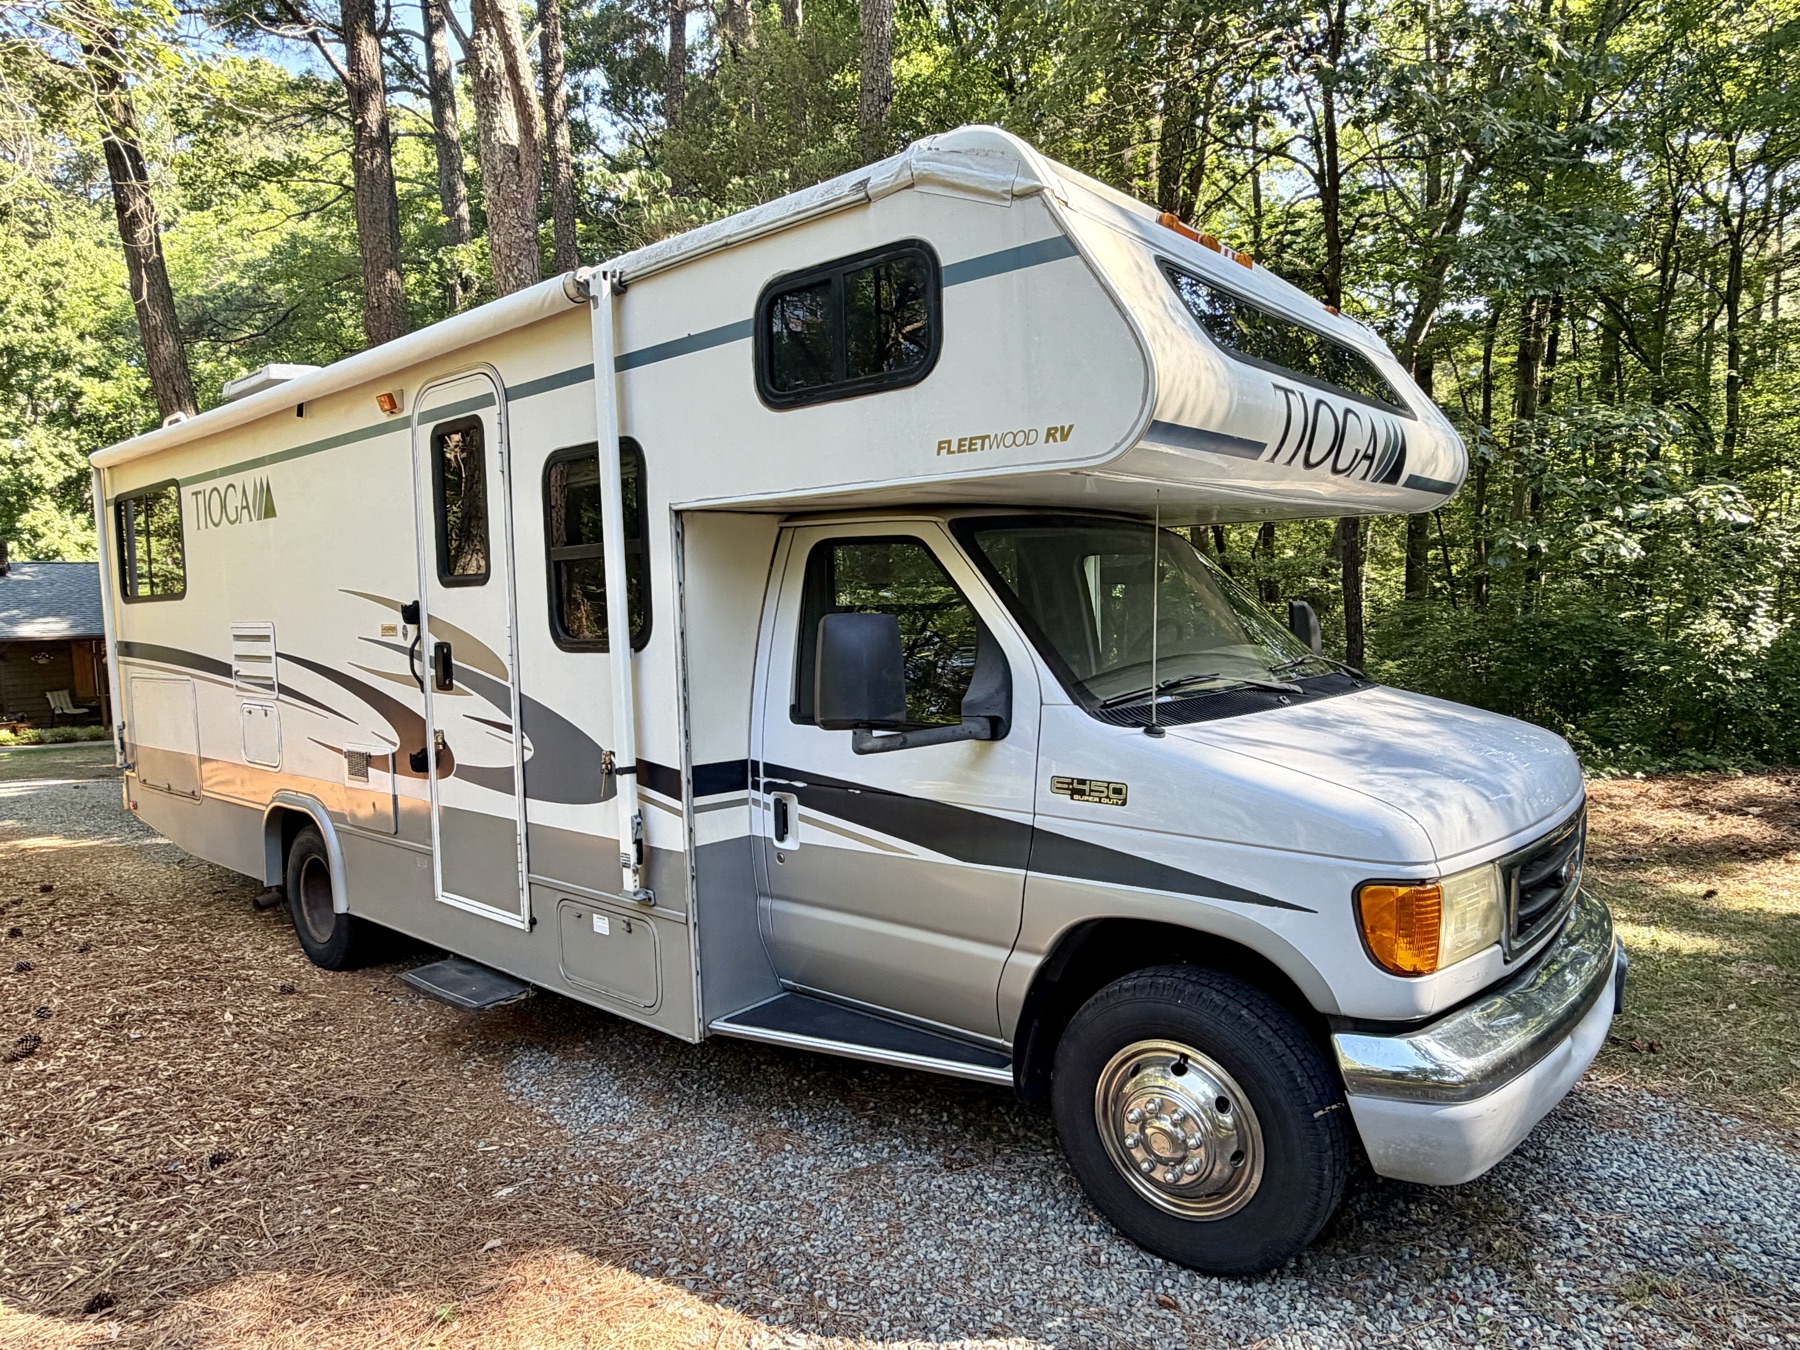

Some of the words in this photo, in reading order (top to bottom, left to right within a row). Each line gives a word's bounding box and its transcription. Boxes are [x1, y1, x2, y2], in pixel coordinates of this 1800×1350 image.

[936, 428, 1039, 457] FLEETWOOD
[1044, 424, 1075, 444] RV
[1265, 381, 1378, 482] TIOGA
[191, 479, 254, 531] TIOGA
[1073, 794, 1099, 802] SUPER
[1100, 797, 1123, 805] DUTY
